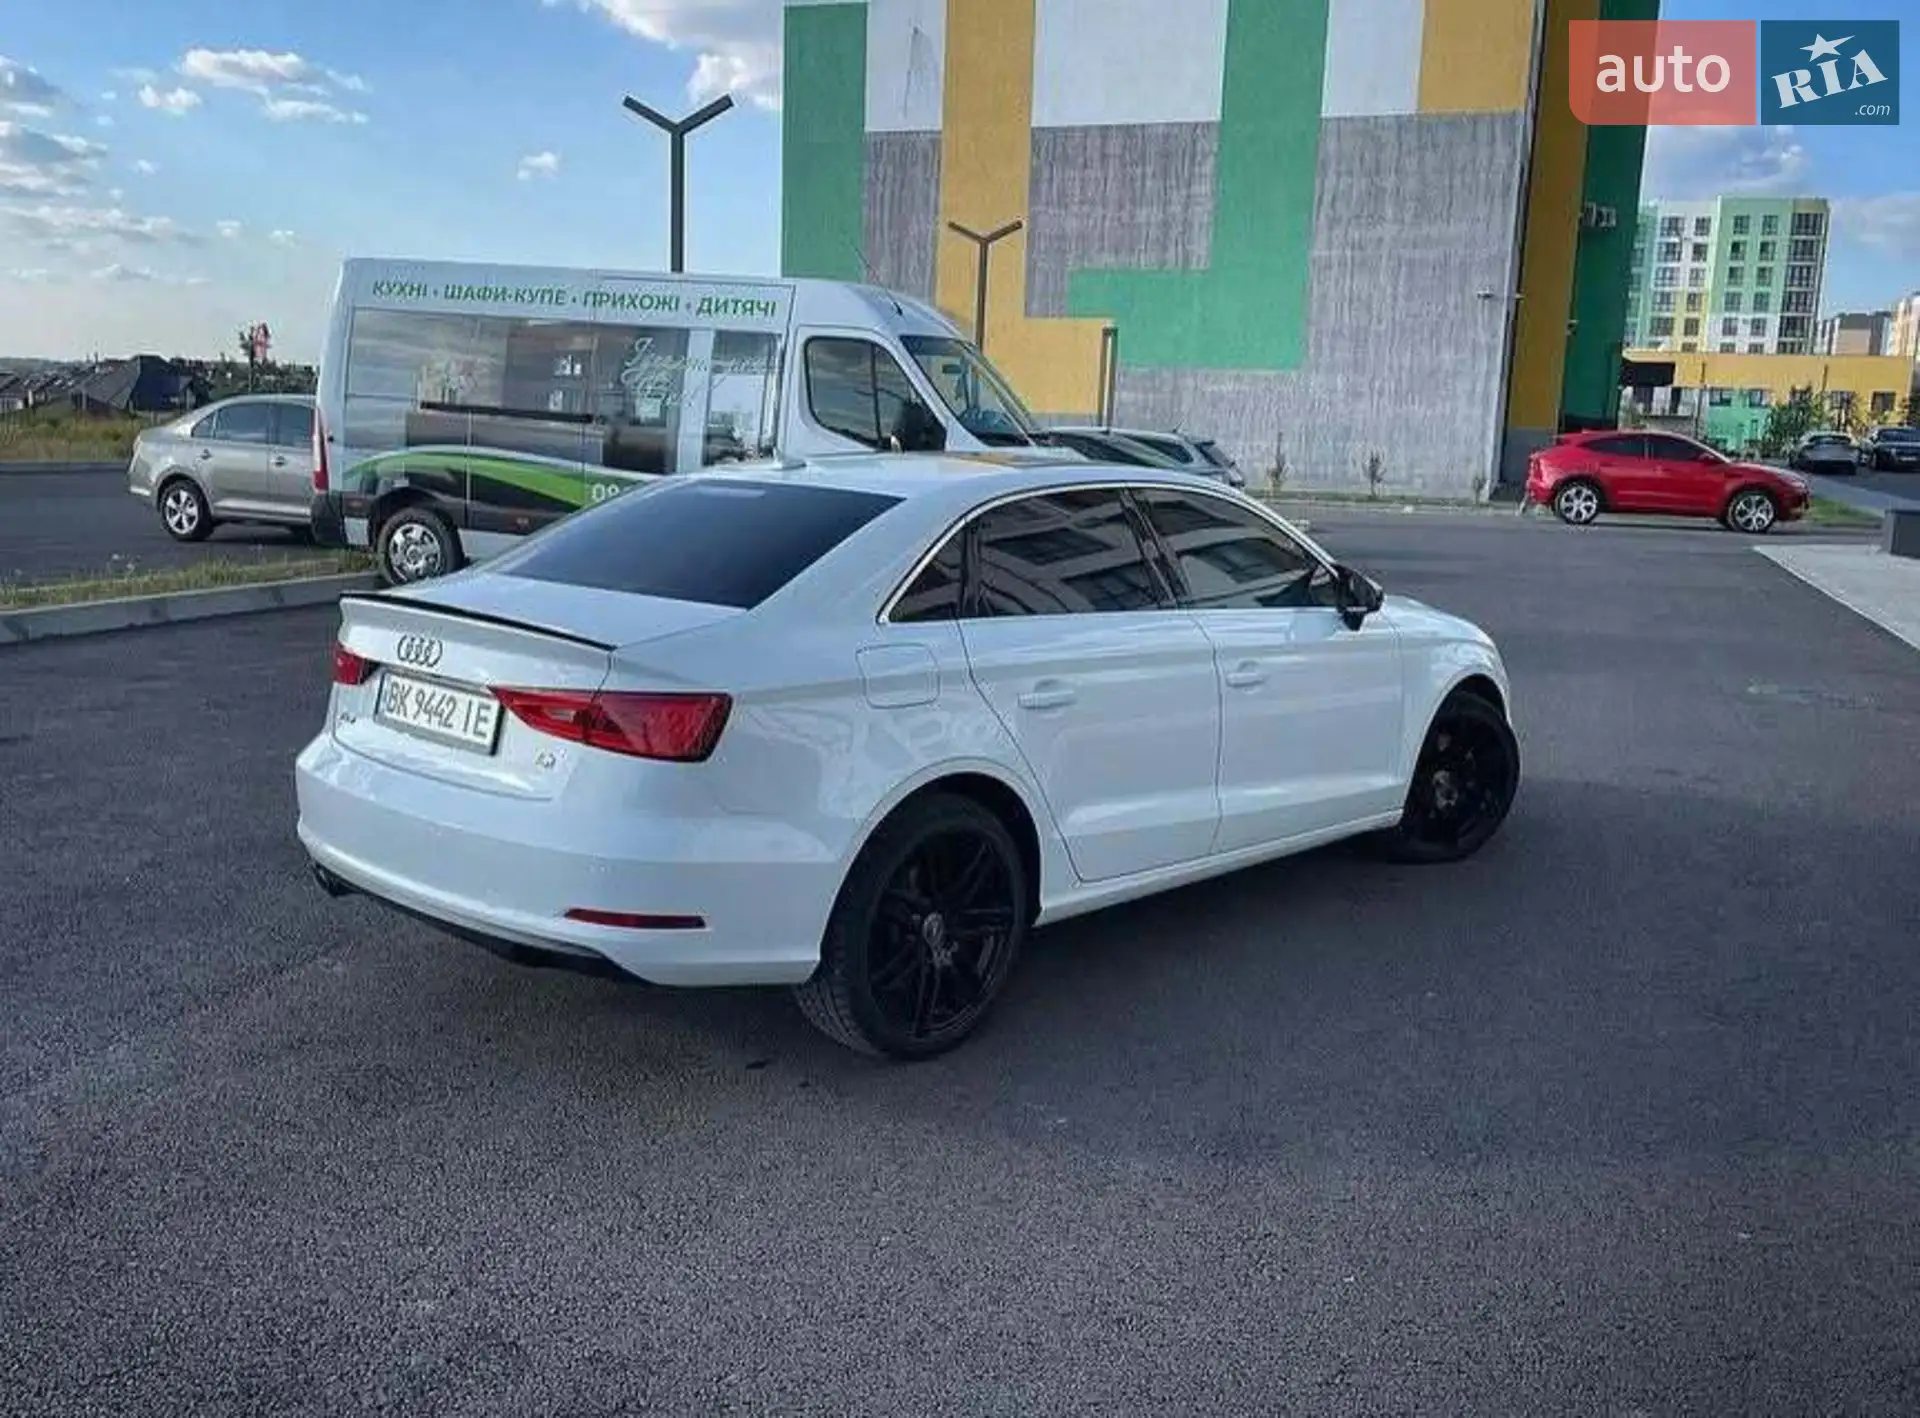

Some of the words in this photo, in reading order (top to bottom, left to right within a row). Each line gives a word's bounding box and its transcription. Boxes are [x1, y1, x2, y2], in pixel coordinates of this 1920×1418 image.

[372, 279, 428, 298] КУХНІ
[444, 283, 565, 306] ШАФИ-КУПЕ
[583, 290, 680, 313] ПРИХОЖІ
[696, 298, 777, 318] ДИТЯЧІ
[415, 689, 456, 728] 9442
